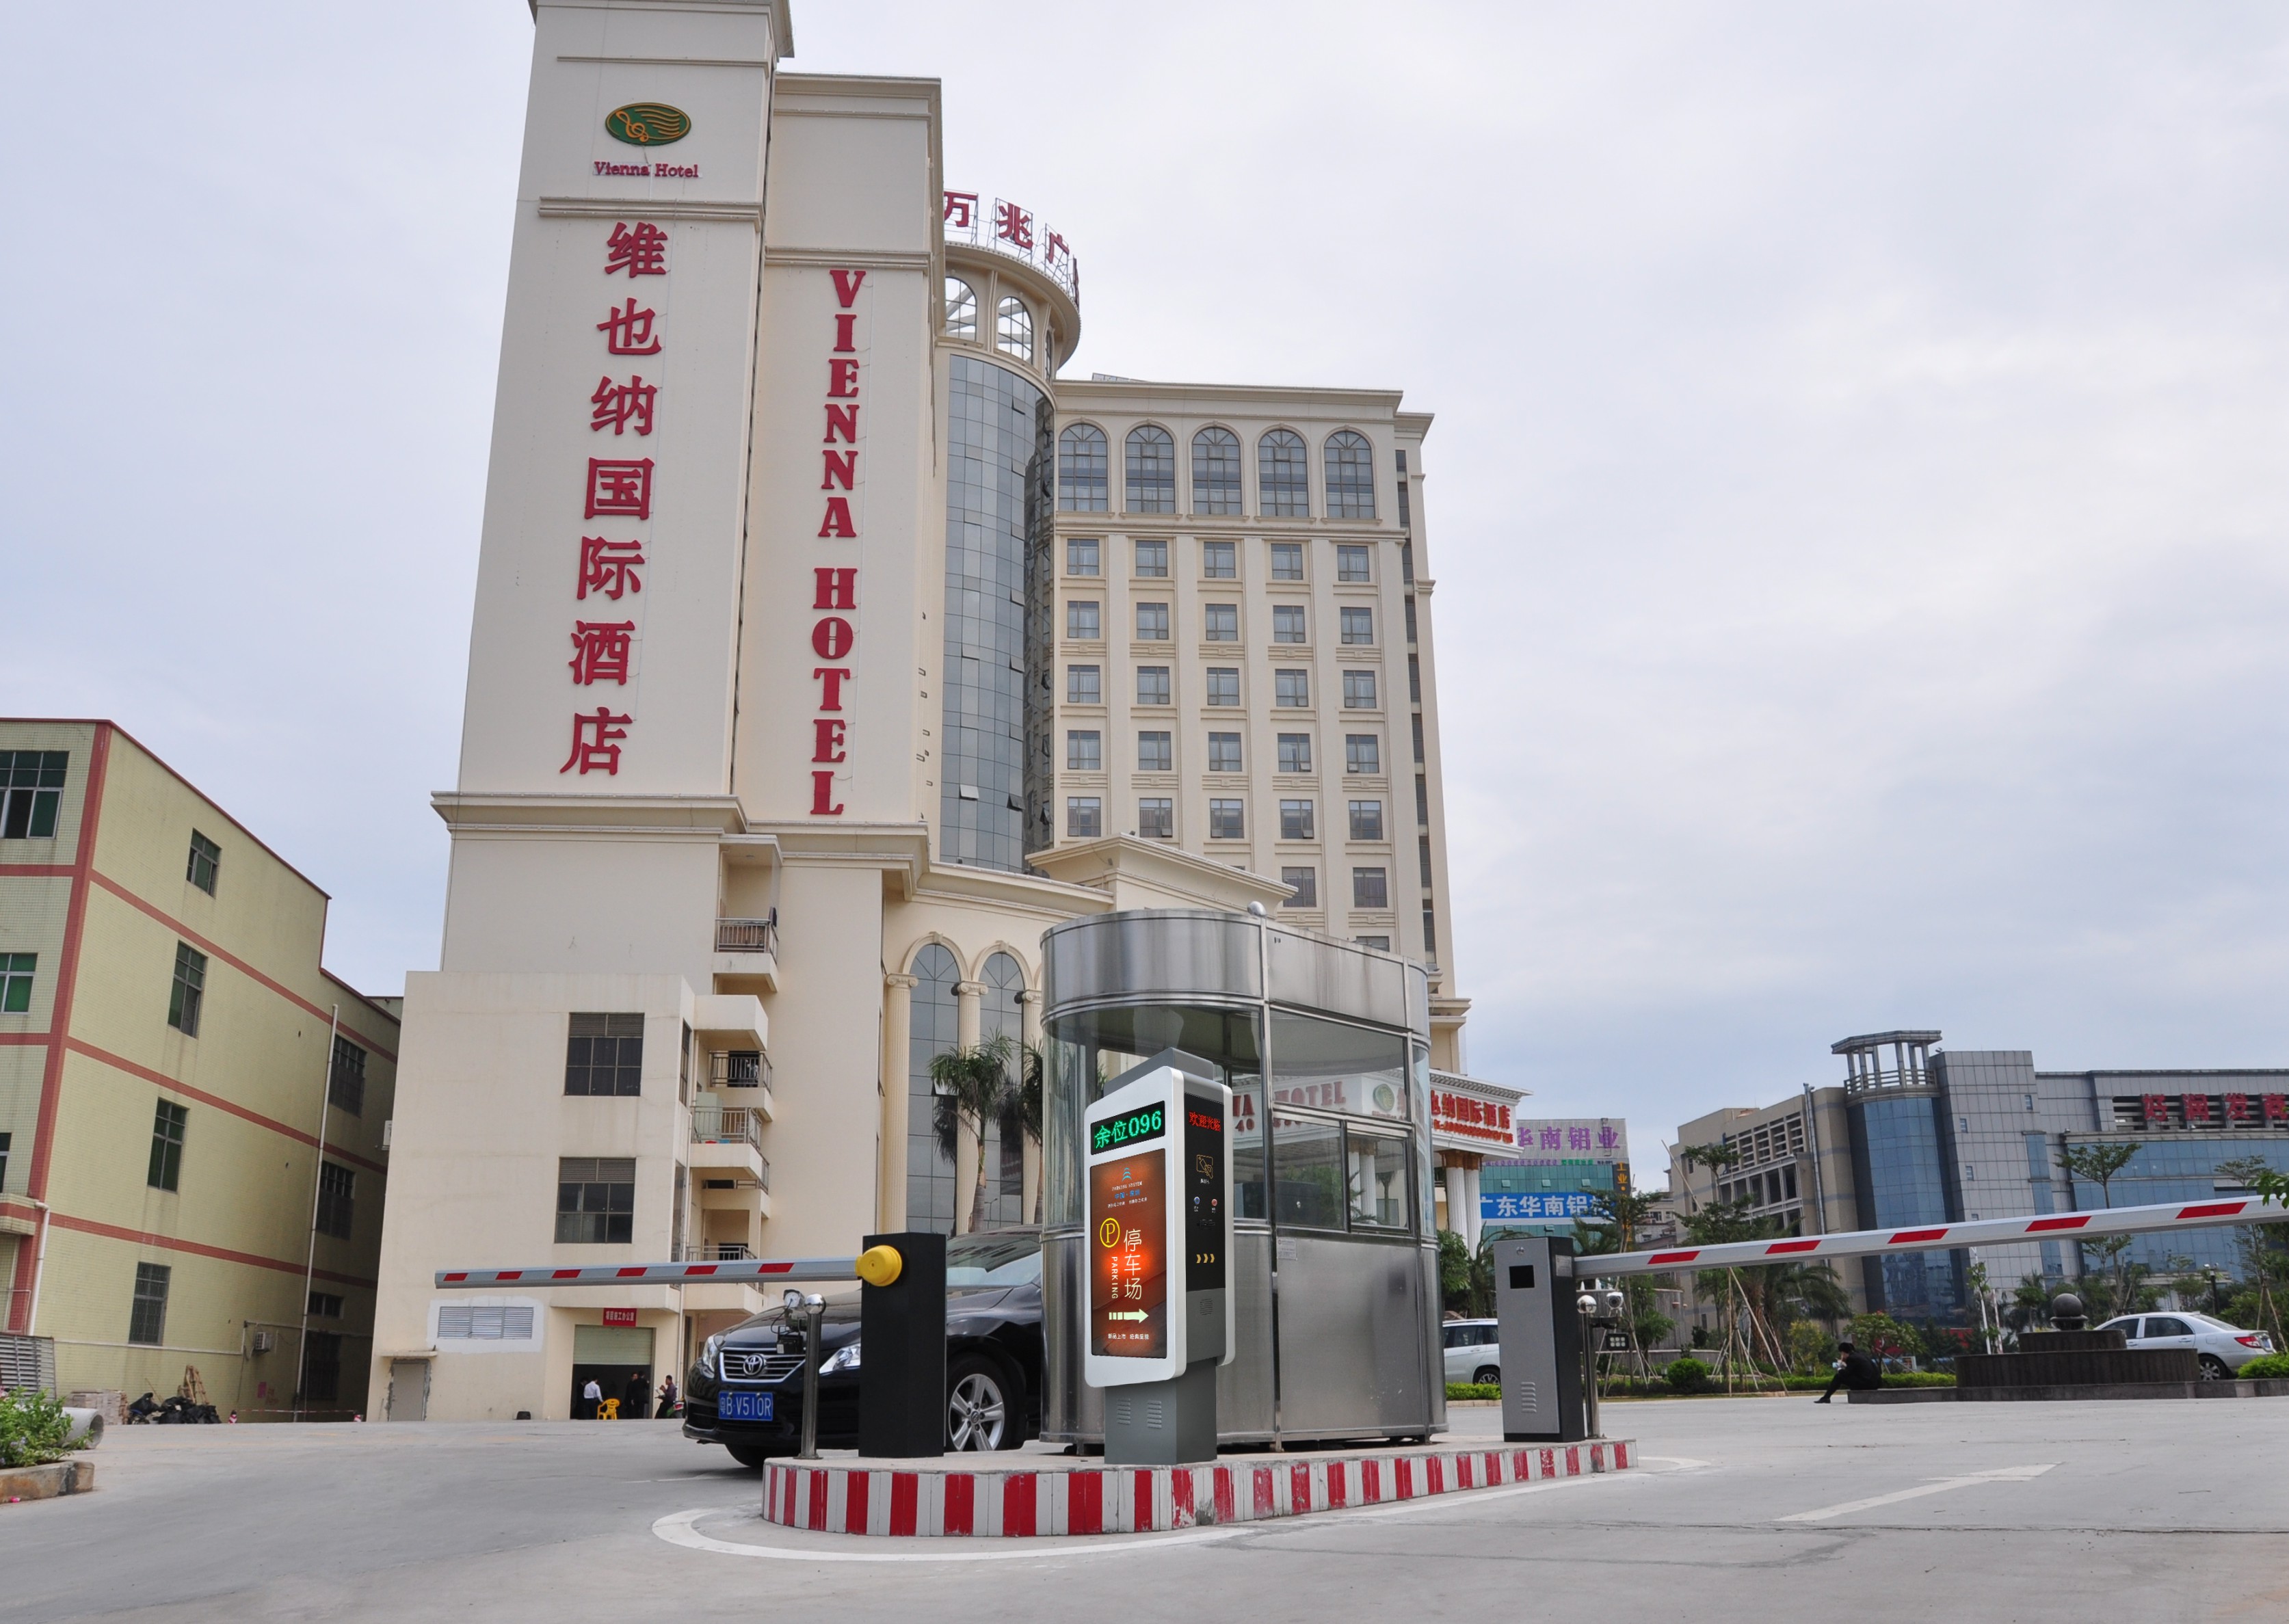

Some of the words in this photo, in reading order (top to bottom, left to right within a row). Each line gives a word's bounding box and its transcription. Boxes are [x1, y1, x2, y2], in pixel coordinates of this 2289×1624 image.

[594, 161, 650, 176] Vienna
[654, 163, 699, 178] Hotel
[818, 269, 866, 538] VIENNA
[559, 222, 668, 775] 维也纳国际酒店
[810, 567, 858, 816] HOTEL
[1094, 1109, 1163, 1149] 余位096
[1124, 1229, 1142, 1300] 停车场
